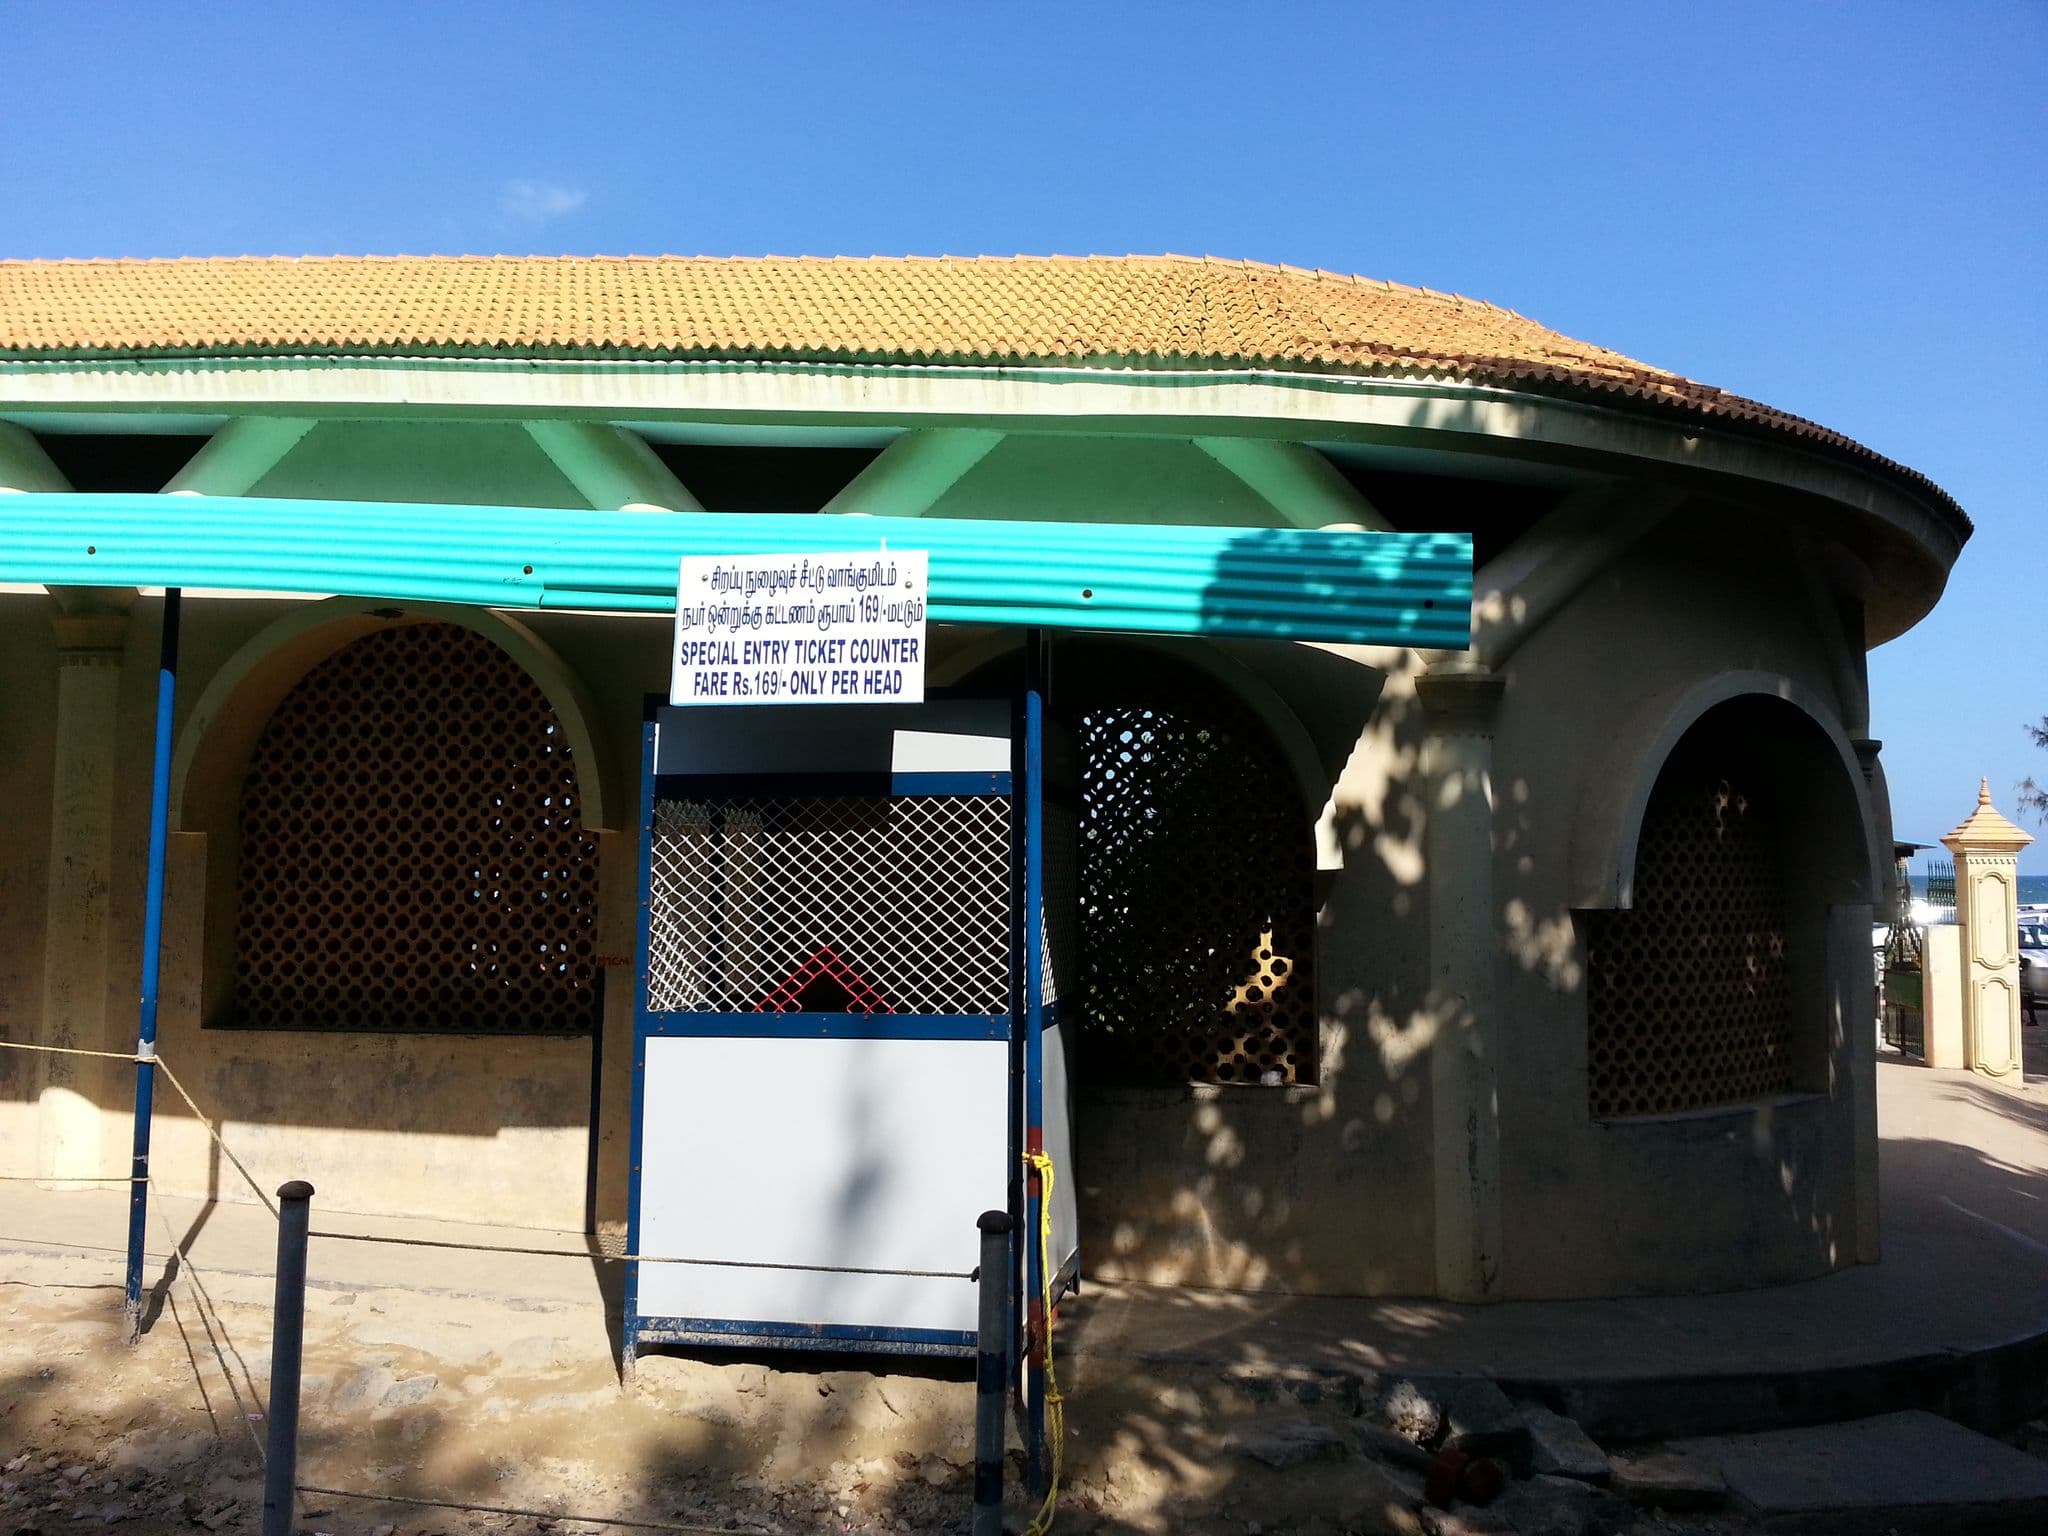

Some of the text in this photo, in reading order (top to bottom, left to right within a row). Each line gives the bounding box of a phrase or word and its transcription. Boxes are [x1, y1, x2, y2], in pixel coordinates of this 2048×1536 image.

[827, 561, 897, 592] வாங்குமிடம்
[682, 601, 706, 631] நபர்
[765, 599, 816, 624] கட்டணம்
[681, 638, 918, 666] SPECIAL ENTRY TICKET COUNTER
[694, 671, 728, 696] FARE
[790, 670, 828, 695] ONLY
[832, 670, 859, 694] PER
[864, 670, 902, 694] HEAD
